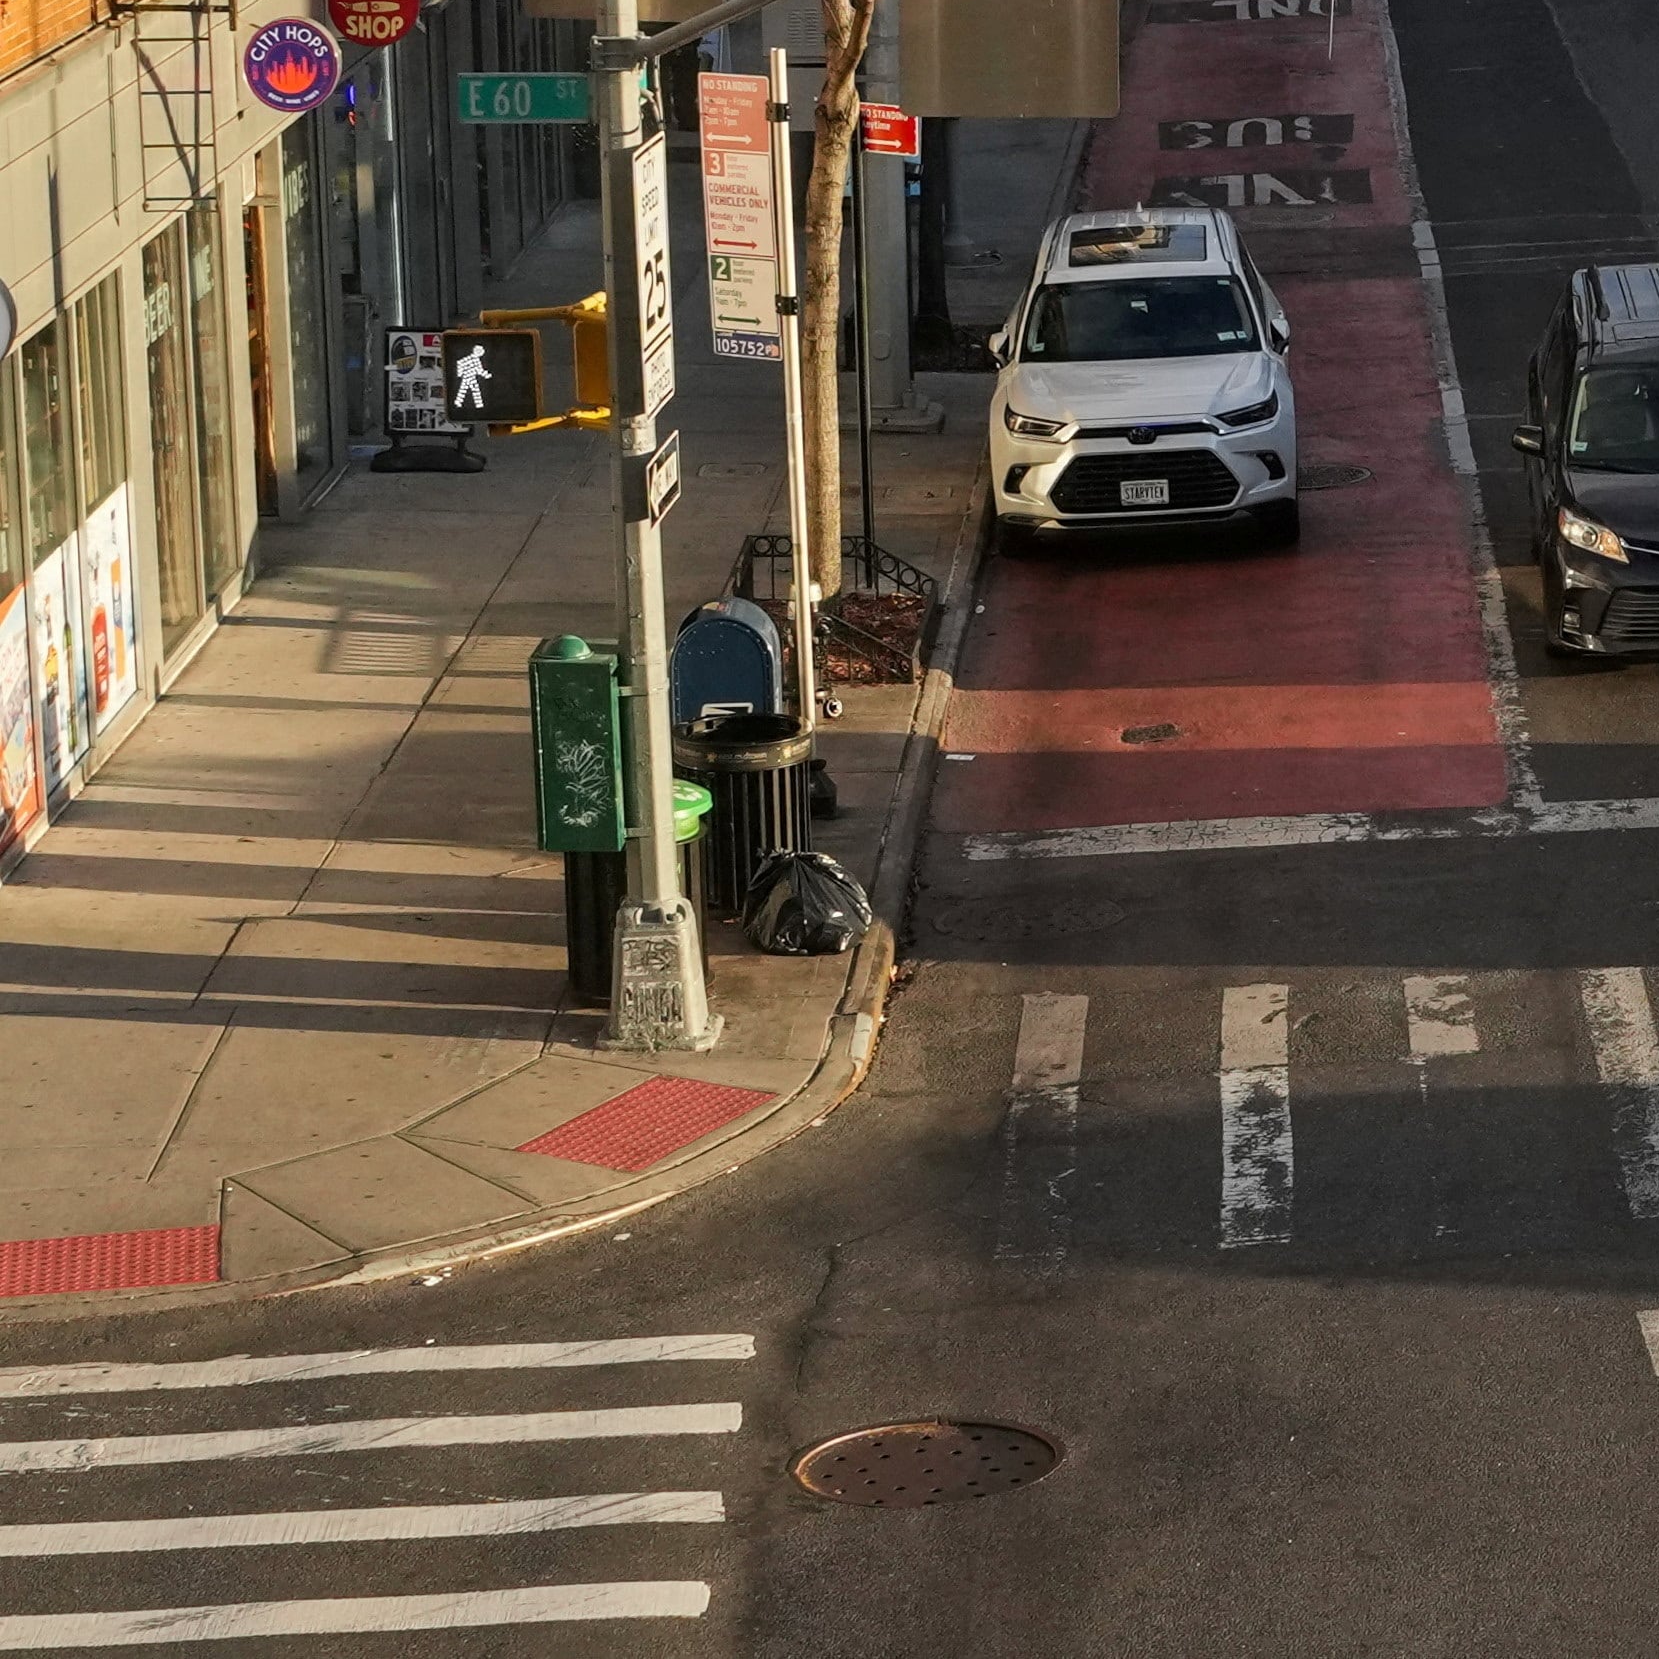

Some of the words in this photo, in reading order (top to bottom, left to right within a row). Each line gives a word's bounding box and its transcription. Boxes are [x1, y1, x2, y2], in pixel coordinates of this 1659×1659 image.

[346, 15, 404, 39] SHOP
[250, 27, 280, 62] CITY
[286, 25, 328, 58] HOPS
[703, 79, 715, 90] NO
[716, 80, 758, 93] STANDING
[470, 80, 485, 117] E
[494, 81, 531, 117] 60
[556, 79, 578, 100] ST
[709, 153, 721, 174] 3
[709, 183, 759, 196] COMMERCIAL
[711, 195, 746, 208] VEHICLES
[749, 198, 768, 209] ONLY
[715, 257, 729, 280] 2
[644, 248, 667, 331] 25
